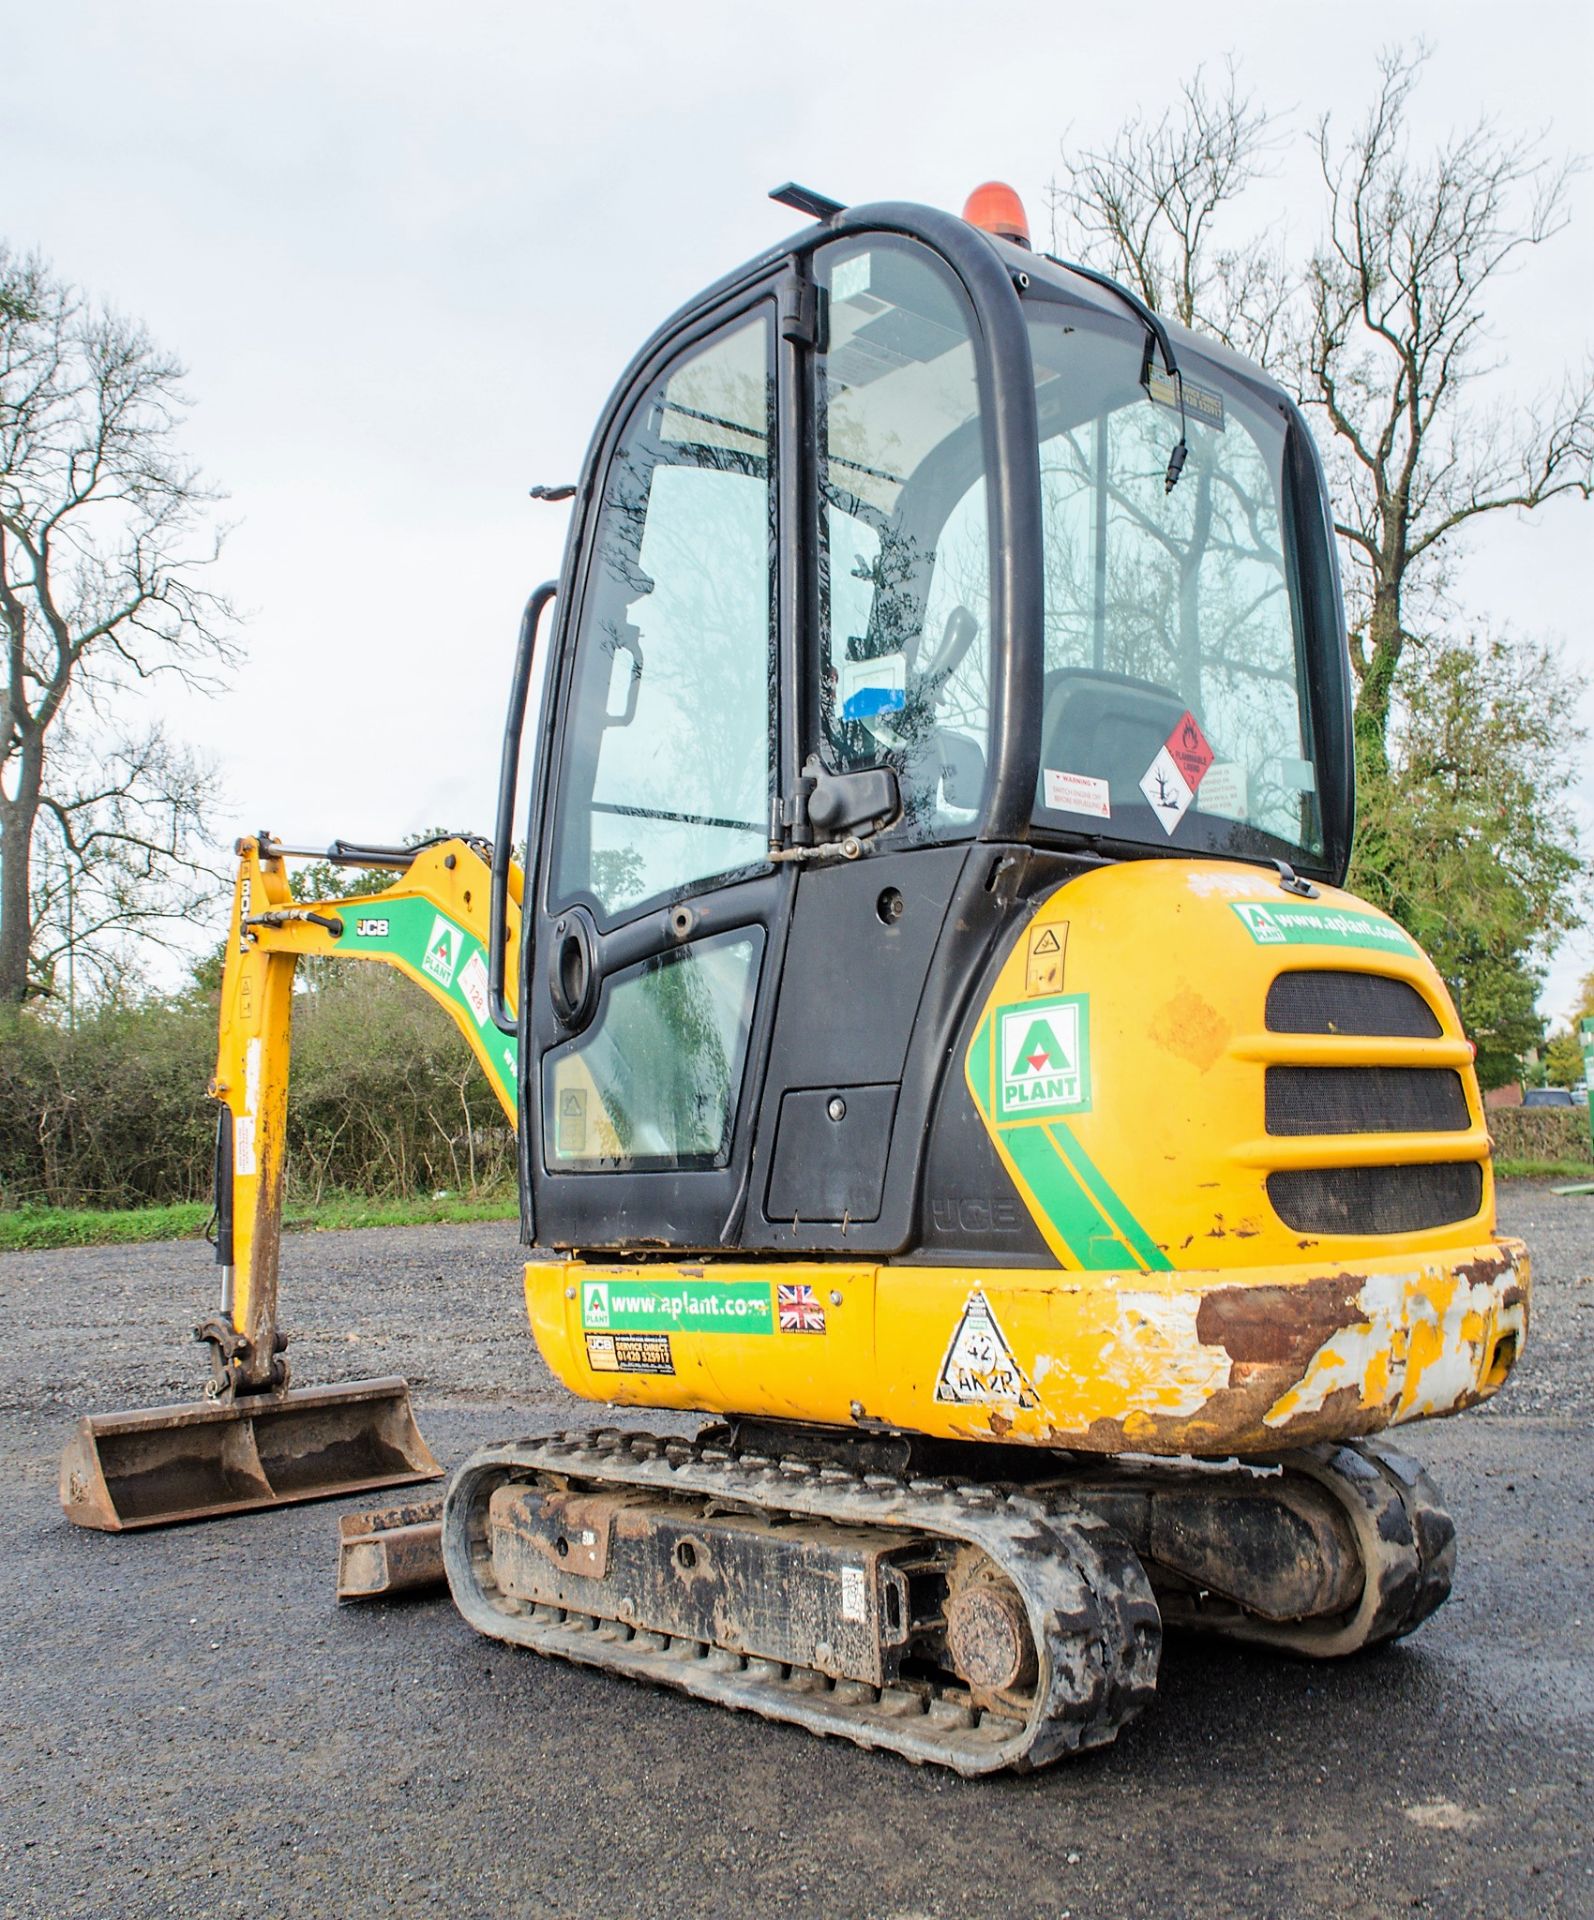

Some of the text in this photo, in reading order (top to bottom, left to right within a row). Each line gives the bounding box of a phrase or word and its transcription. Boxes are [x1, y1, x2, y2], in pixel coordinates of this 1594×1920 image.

[1062, 775, 1092, 786] WARNING
[357, 919, 389, 937] JCB
[1274, 913, 1407, 944] www.aplant.com
[425, 956, 451, 981] PLANT
[1011, 1019, 1071, 1077] A
[1005, 1076, 1077, 1104] PLANT
[586, 1315, 608, 1323] PLANT
[589, 1338, 613, 1350] JCB
[615, 1341, 669, 1353] SERVICE DIRECT
[617, 1350, 641, 1362] 01420
